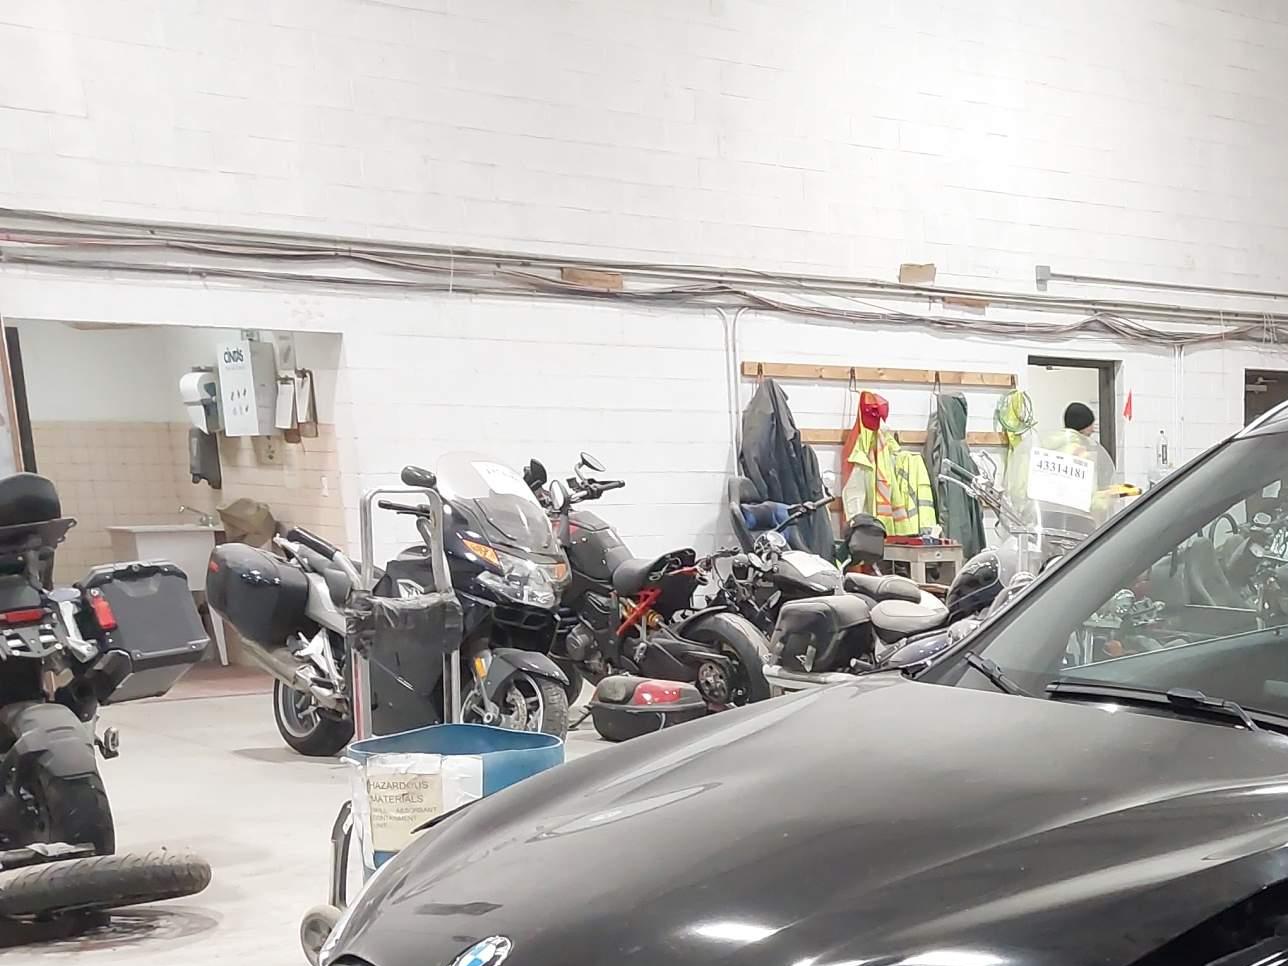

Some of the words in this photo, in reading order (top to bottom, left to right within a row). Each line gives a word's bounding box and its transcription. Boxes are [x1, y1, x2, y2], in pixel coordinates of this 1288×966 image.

[1036, 459, 1085, 480] 43314181
[369, 781, 429, 790] HAZARDOUS
[370, 794, 424, 804] MATERIALS
